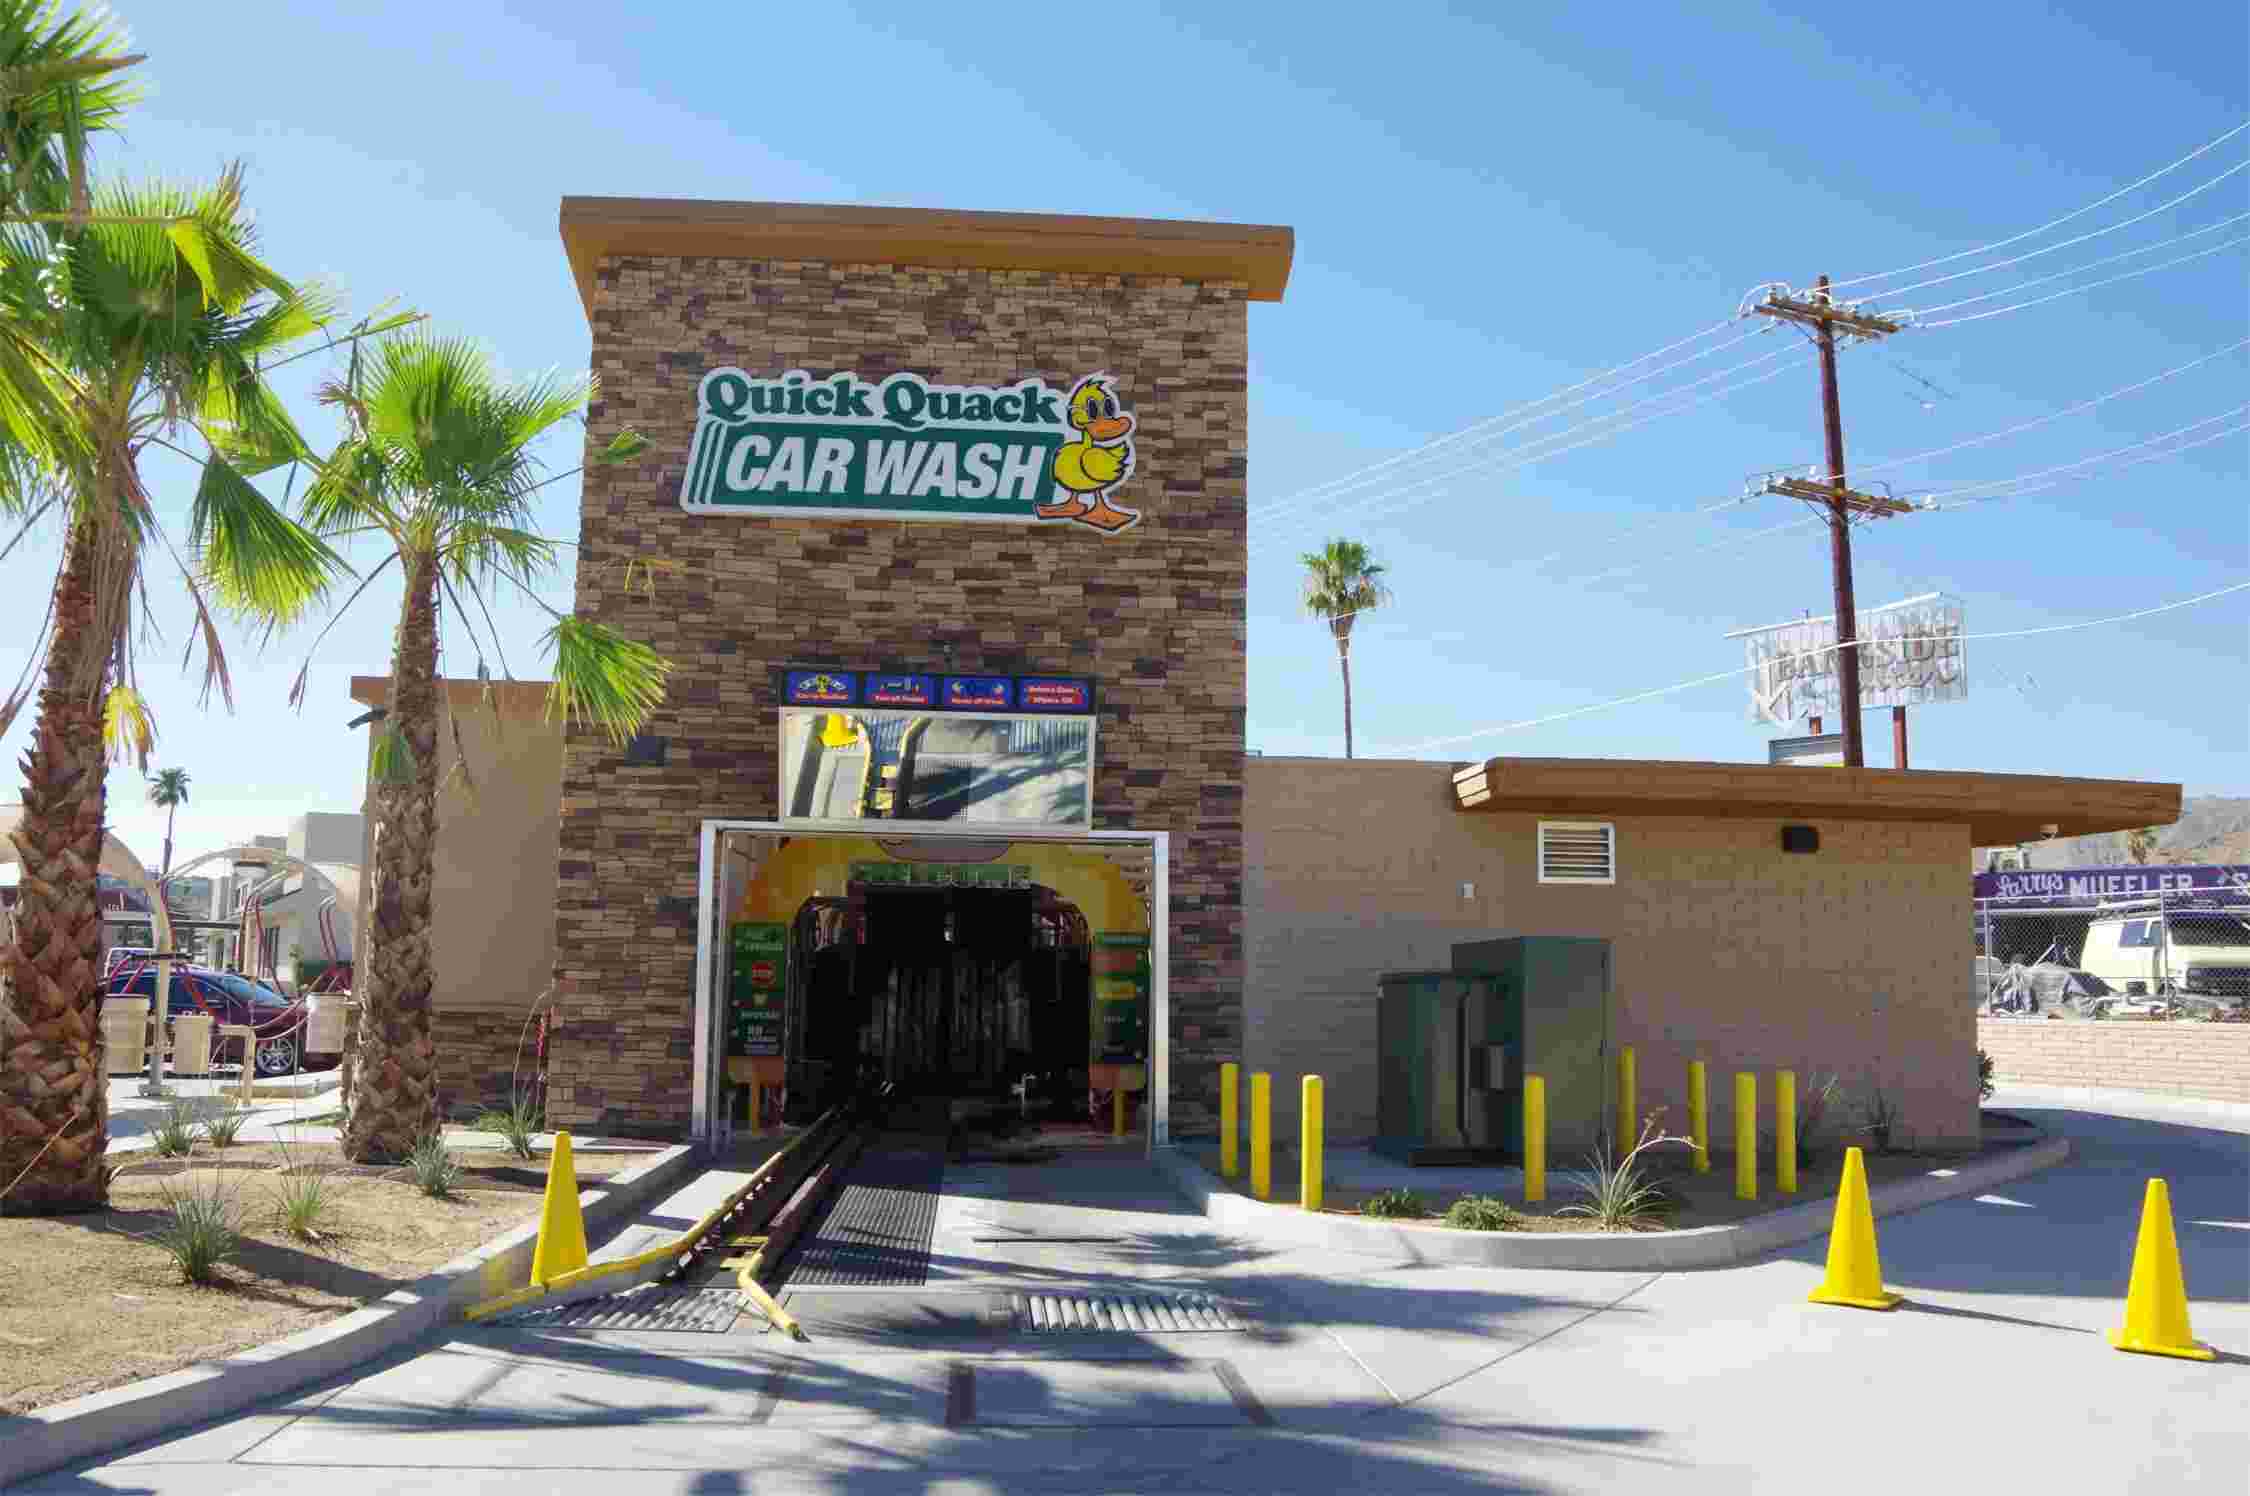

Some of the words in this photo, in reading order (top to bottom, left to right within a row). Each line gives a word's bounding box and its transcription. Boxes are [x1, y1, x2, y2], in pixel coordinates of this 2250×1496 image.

[706, 373, 874, 422] Quick
[883, 379, 1061, 427] Quack
[726, 434, 855, 493] CAR
[863, 438, 1047, 500] WASH
[2069, 872, 2193, 901] MUFFLER
